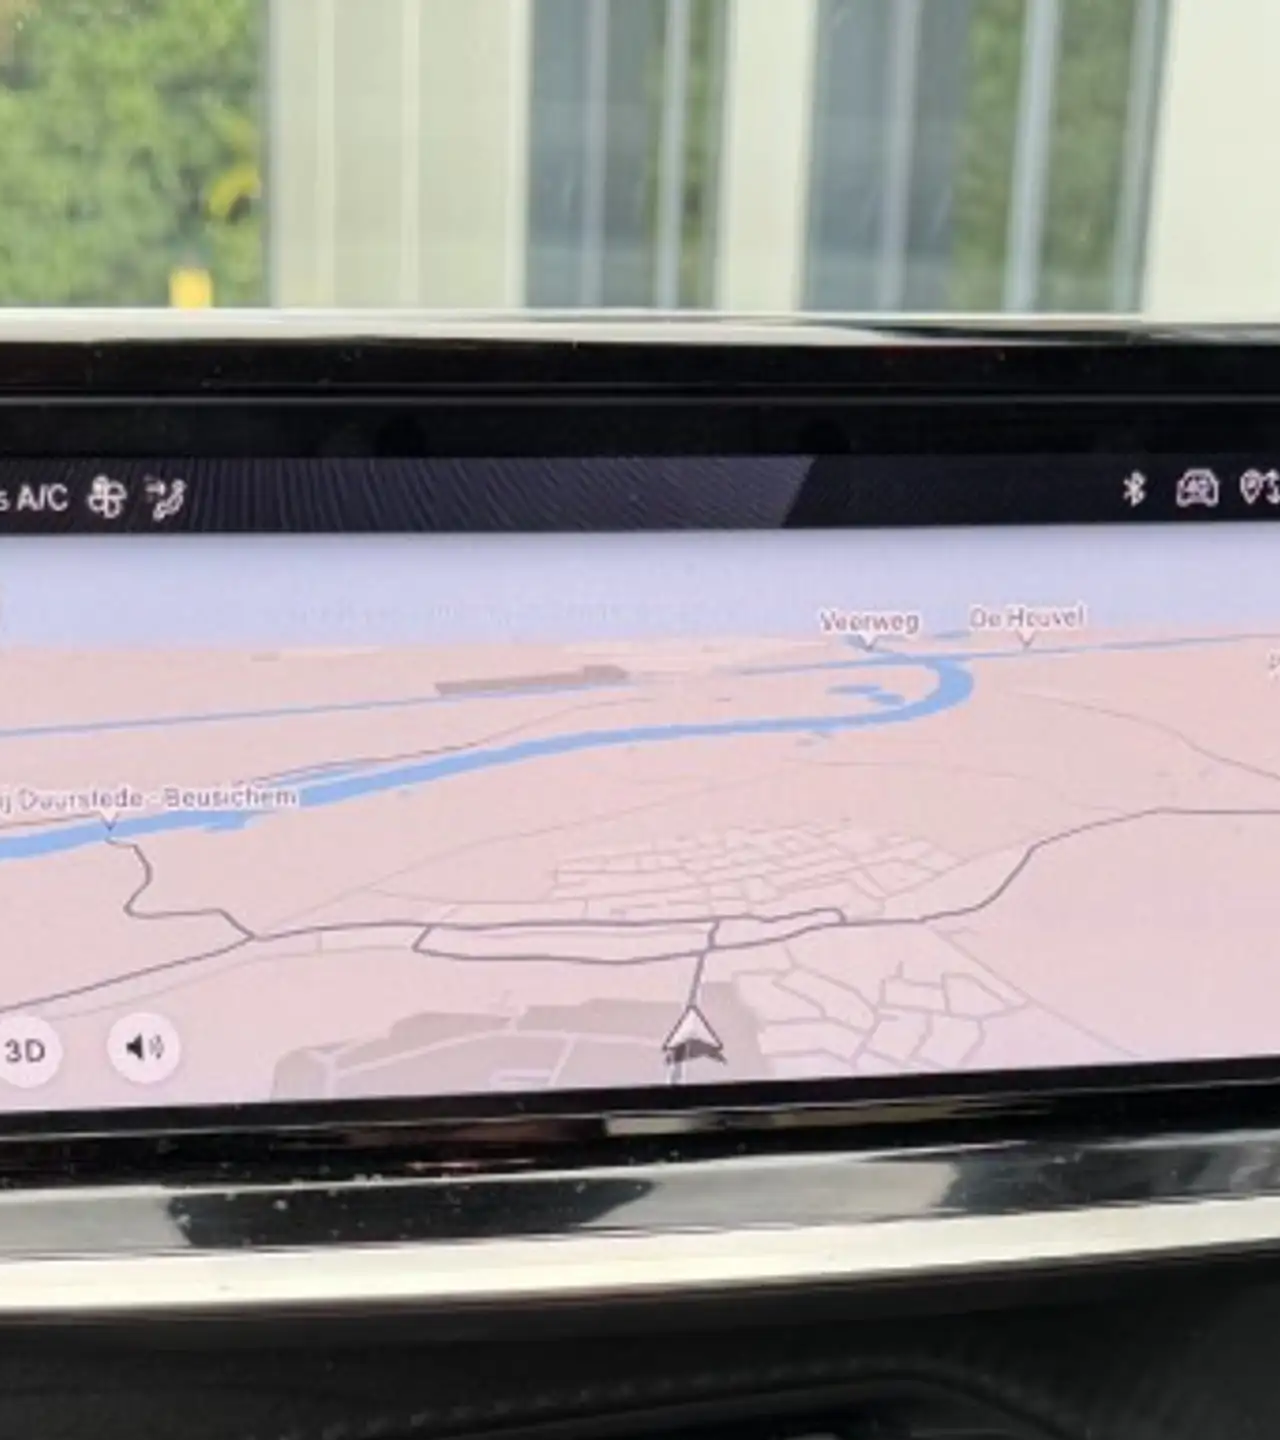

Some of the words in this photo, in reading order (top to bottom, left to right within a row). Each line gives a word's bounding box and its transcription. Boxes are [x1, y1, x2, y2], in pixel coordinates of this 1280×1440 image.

[17, 484, 70, 511] A/C
[164, 786, 297, 808] Beusichem
[4, 1038, 46, 1064] 3D
